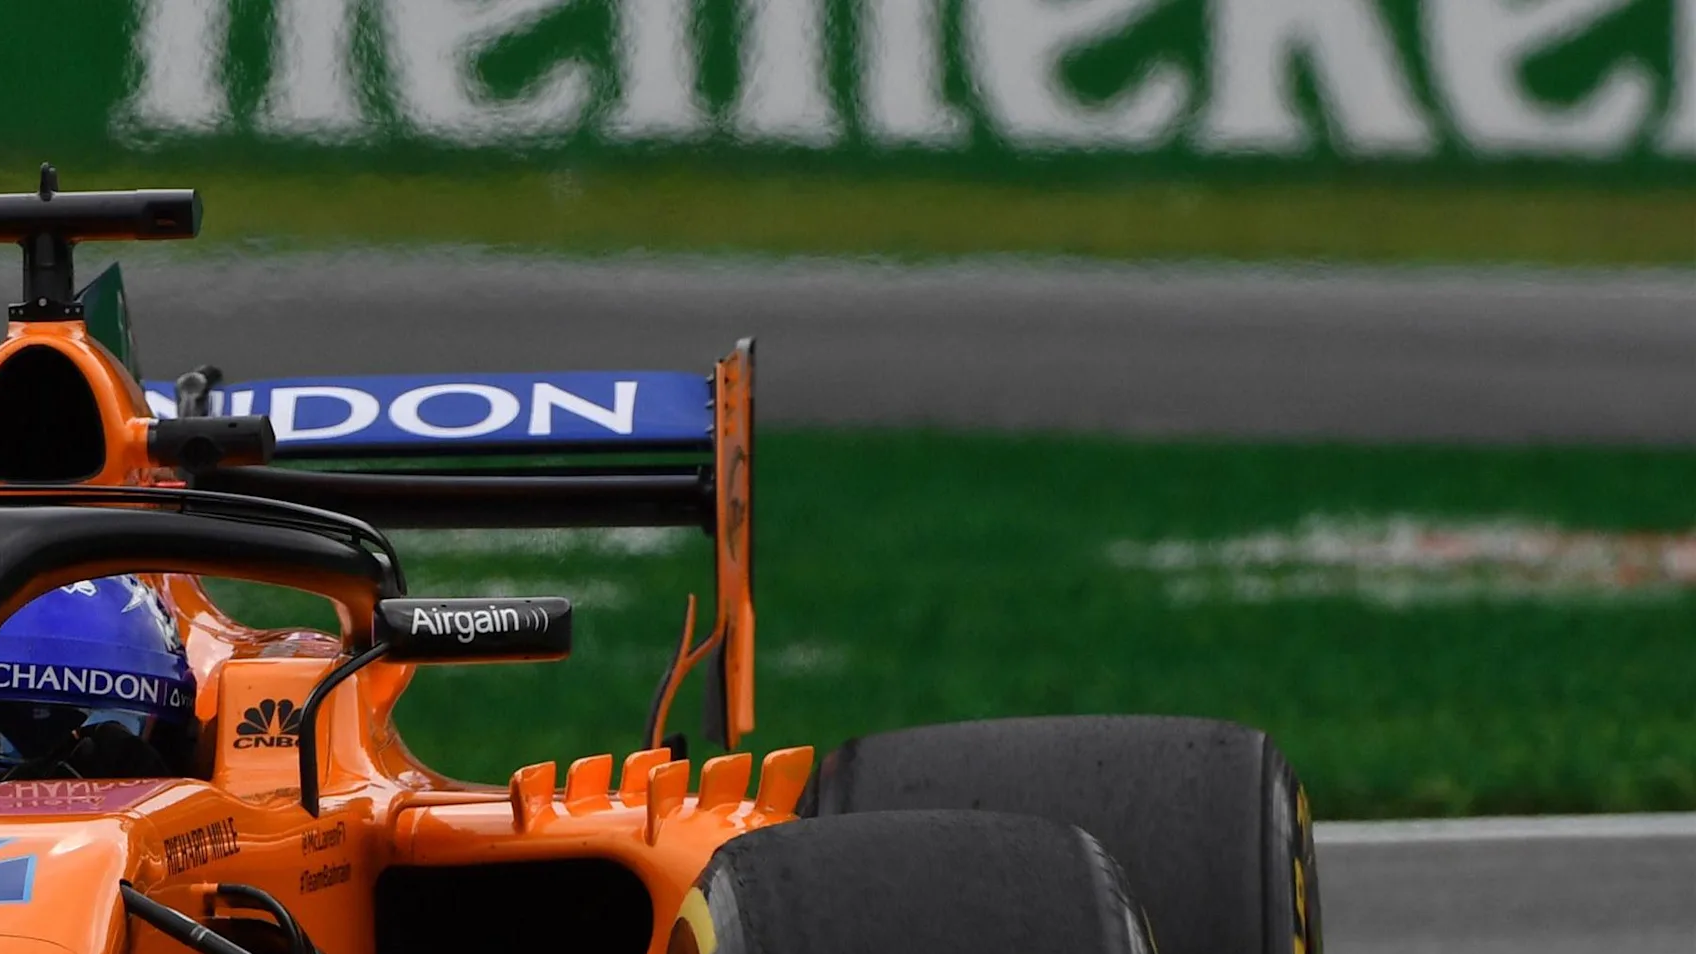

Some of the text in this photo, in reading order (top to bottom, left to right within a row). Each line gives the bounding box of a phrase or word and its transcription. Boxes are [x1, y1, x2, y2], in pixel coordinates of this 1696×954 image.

[411, 605, 519, 643] Airgain
[233, 736, 300, 749] CNB
[164, 816, 241, 876] RICHARD MILLE
